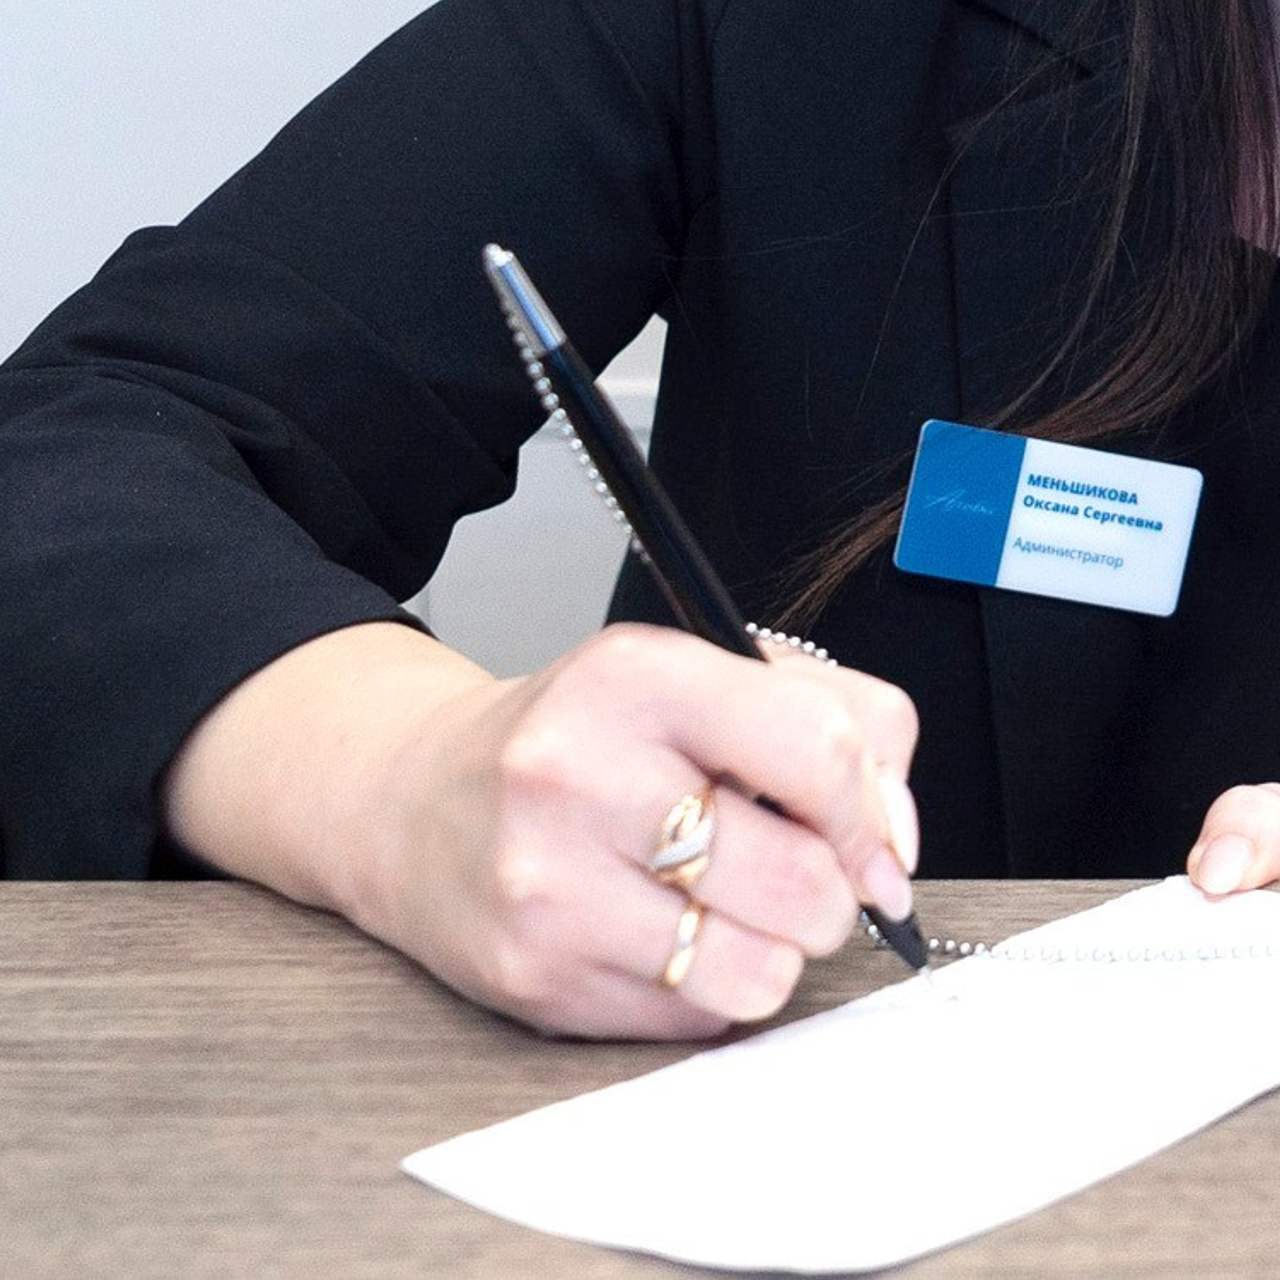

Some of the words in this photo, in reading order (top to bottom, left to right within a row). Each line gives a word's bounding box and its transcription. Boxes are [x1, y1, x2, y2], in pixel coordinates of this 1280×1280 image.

[1027, 474, 1139, 505] МЕНЬШИКОВА
[1023, 495, 1080, 516] Оксана
[1083, 506, 1164, 532] Сергеевна
[1013, 537, 1124, 569] Администратор
